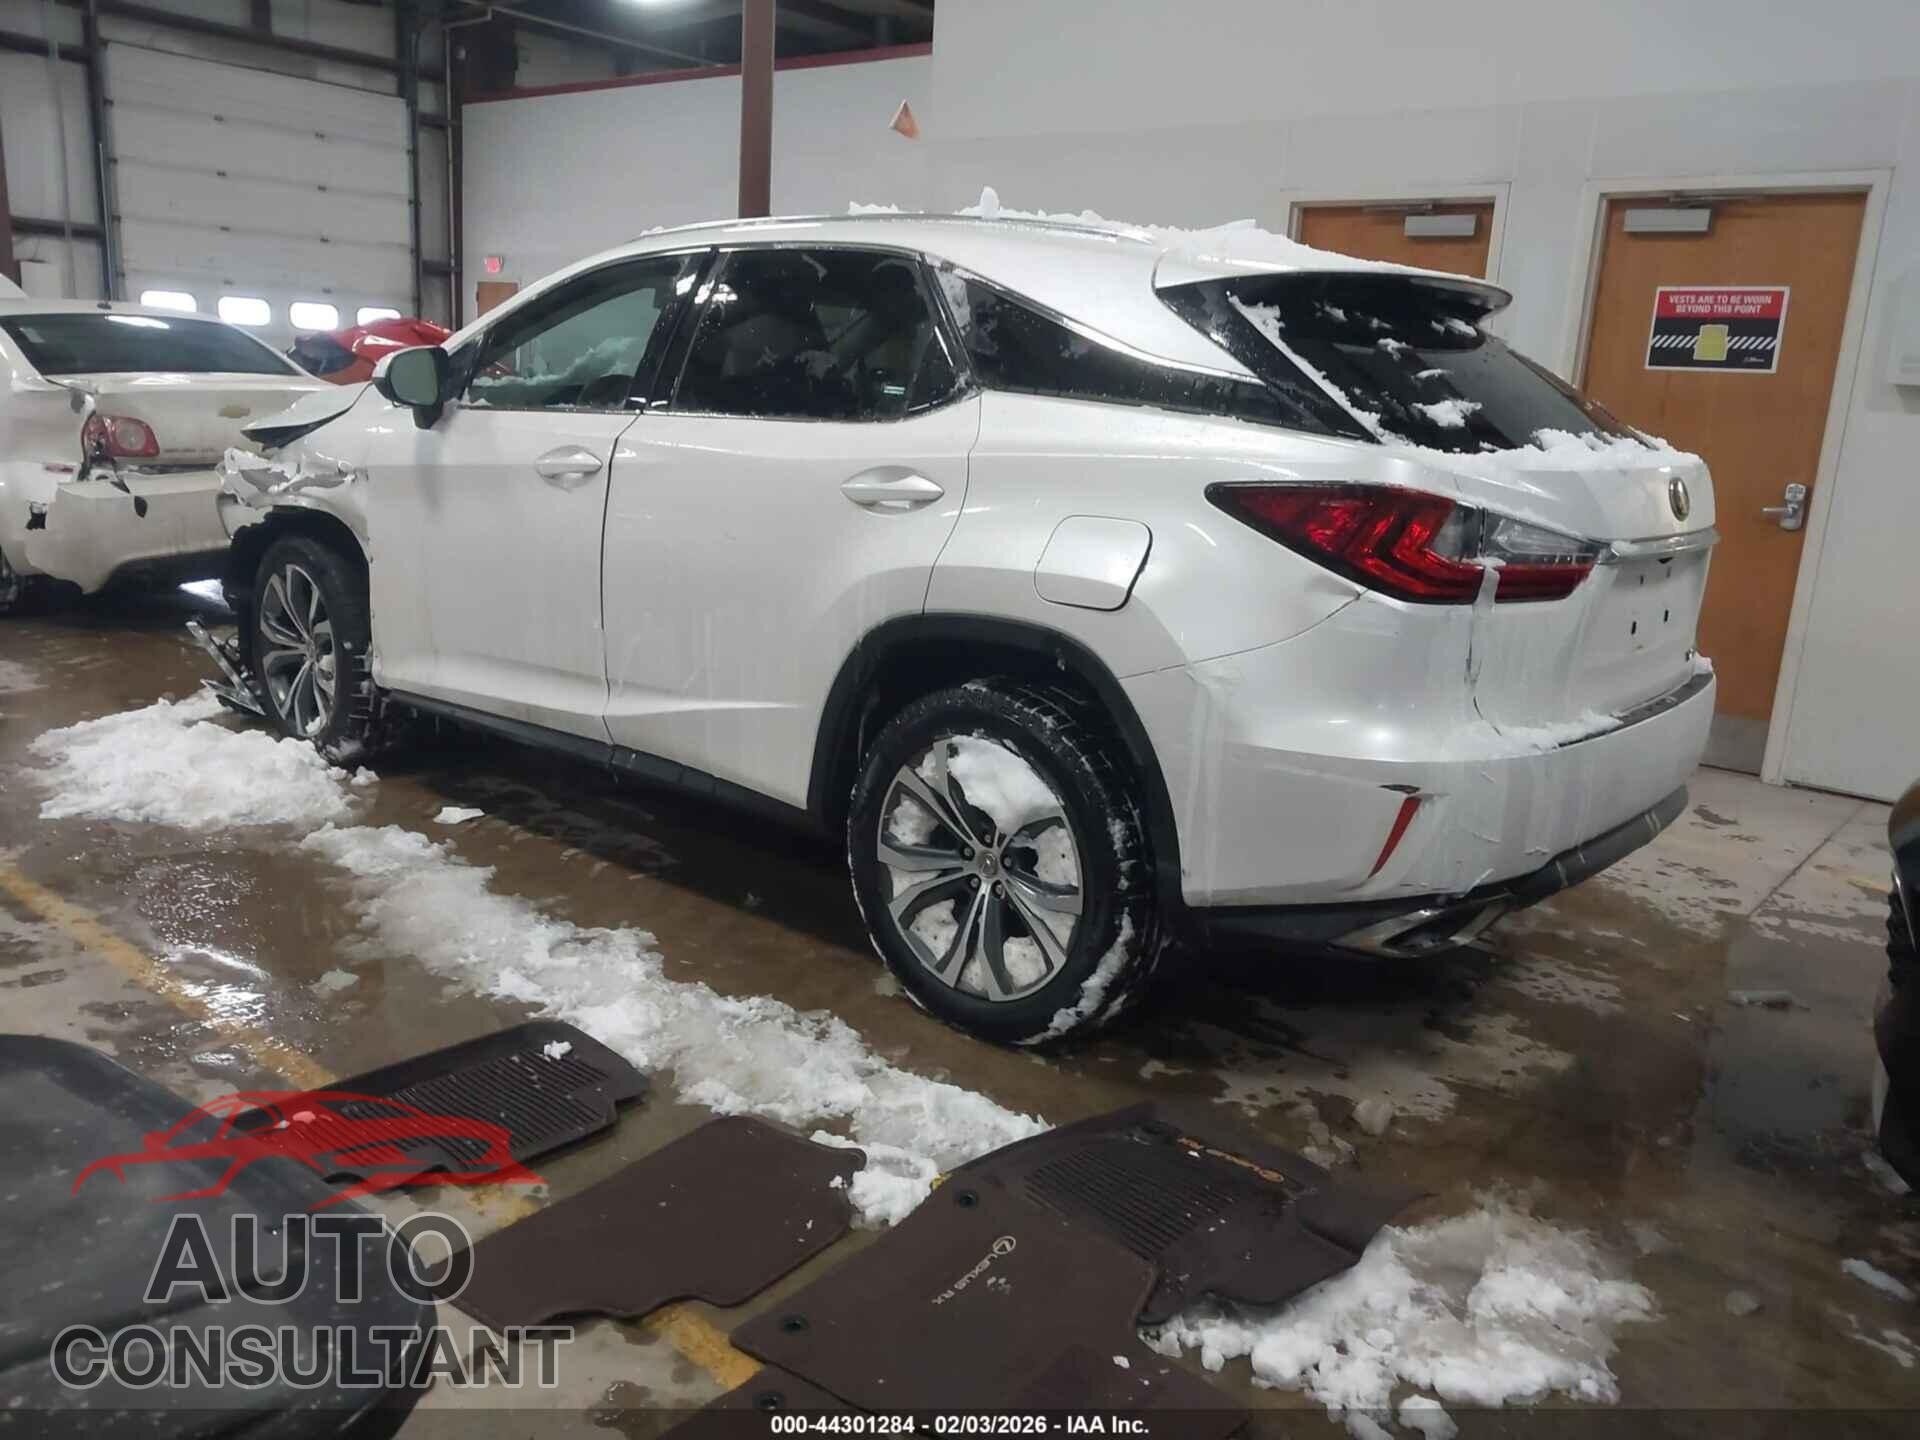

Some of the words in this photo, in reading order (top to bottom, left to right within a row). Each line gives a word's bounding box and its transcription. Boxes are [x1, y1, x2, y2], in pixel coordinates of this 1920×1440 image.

[1669, 295, 1695, 304] VESTS
[1696, 295, 1714, 304] ARE
[1717, 295, 1728, 304] TO
[1730, 296, 1742, 304] BE
[1743, 296, 1772, 304] WORN
[1676, 304, 1712, 313] BEYOND
[1713, 304, 1732, 313] THIS
[1734, 305, 1762, 314] POINT
